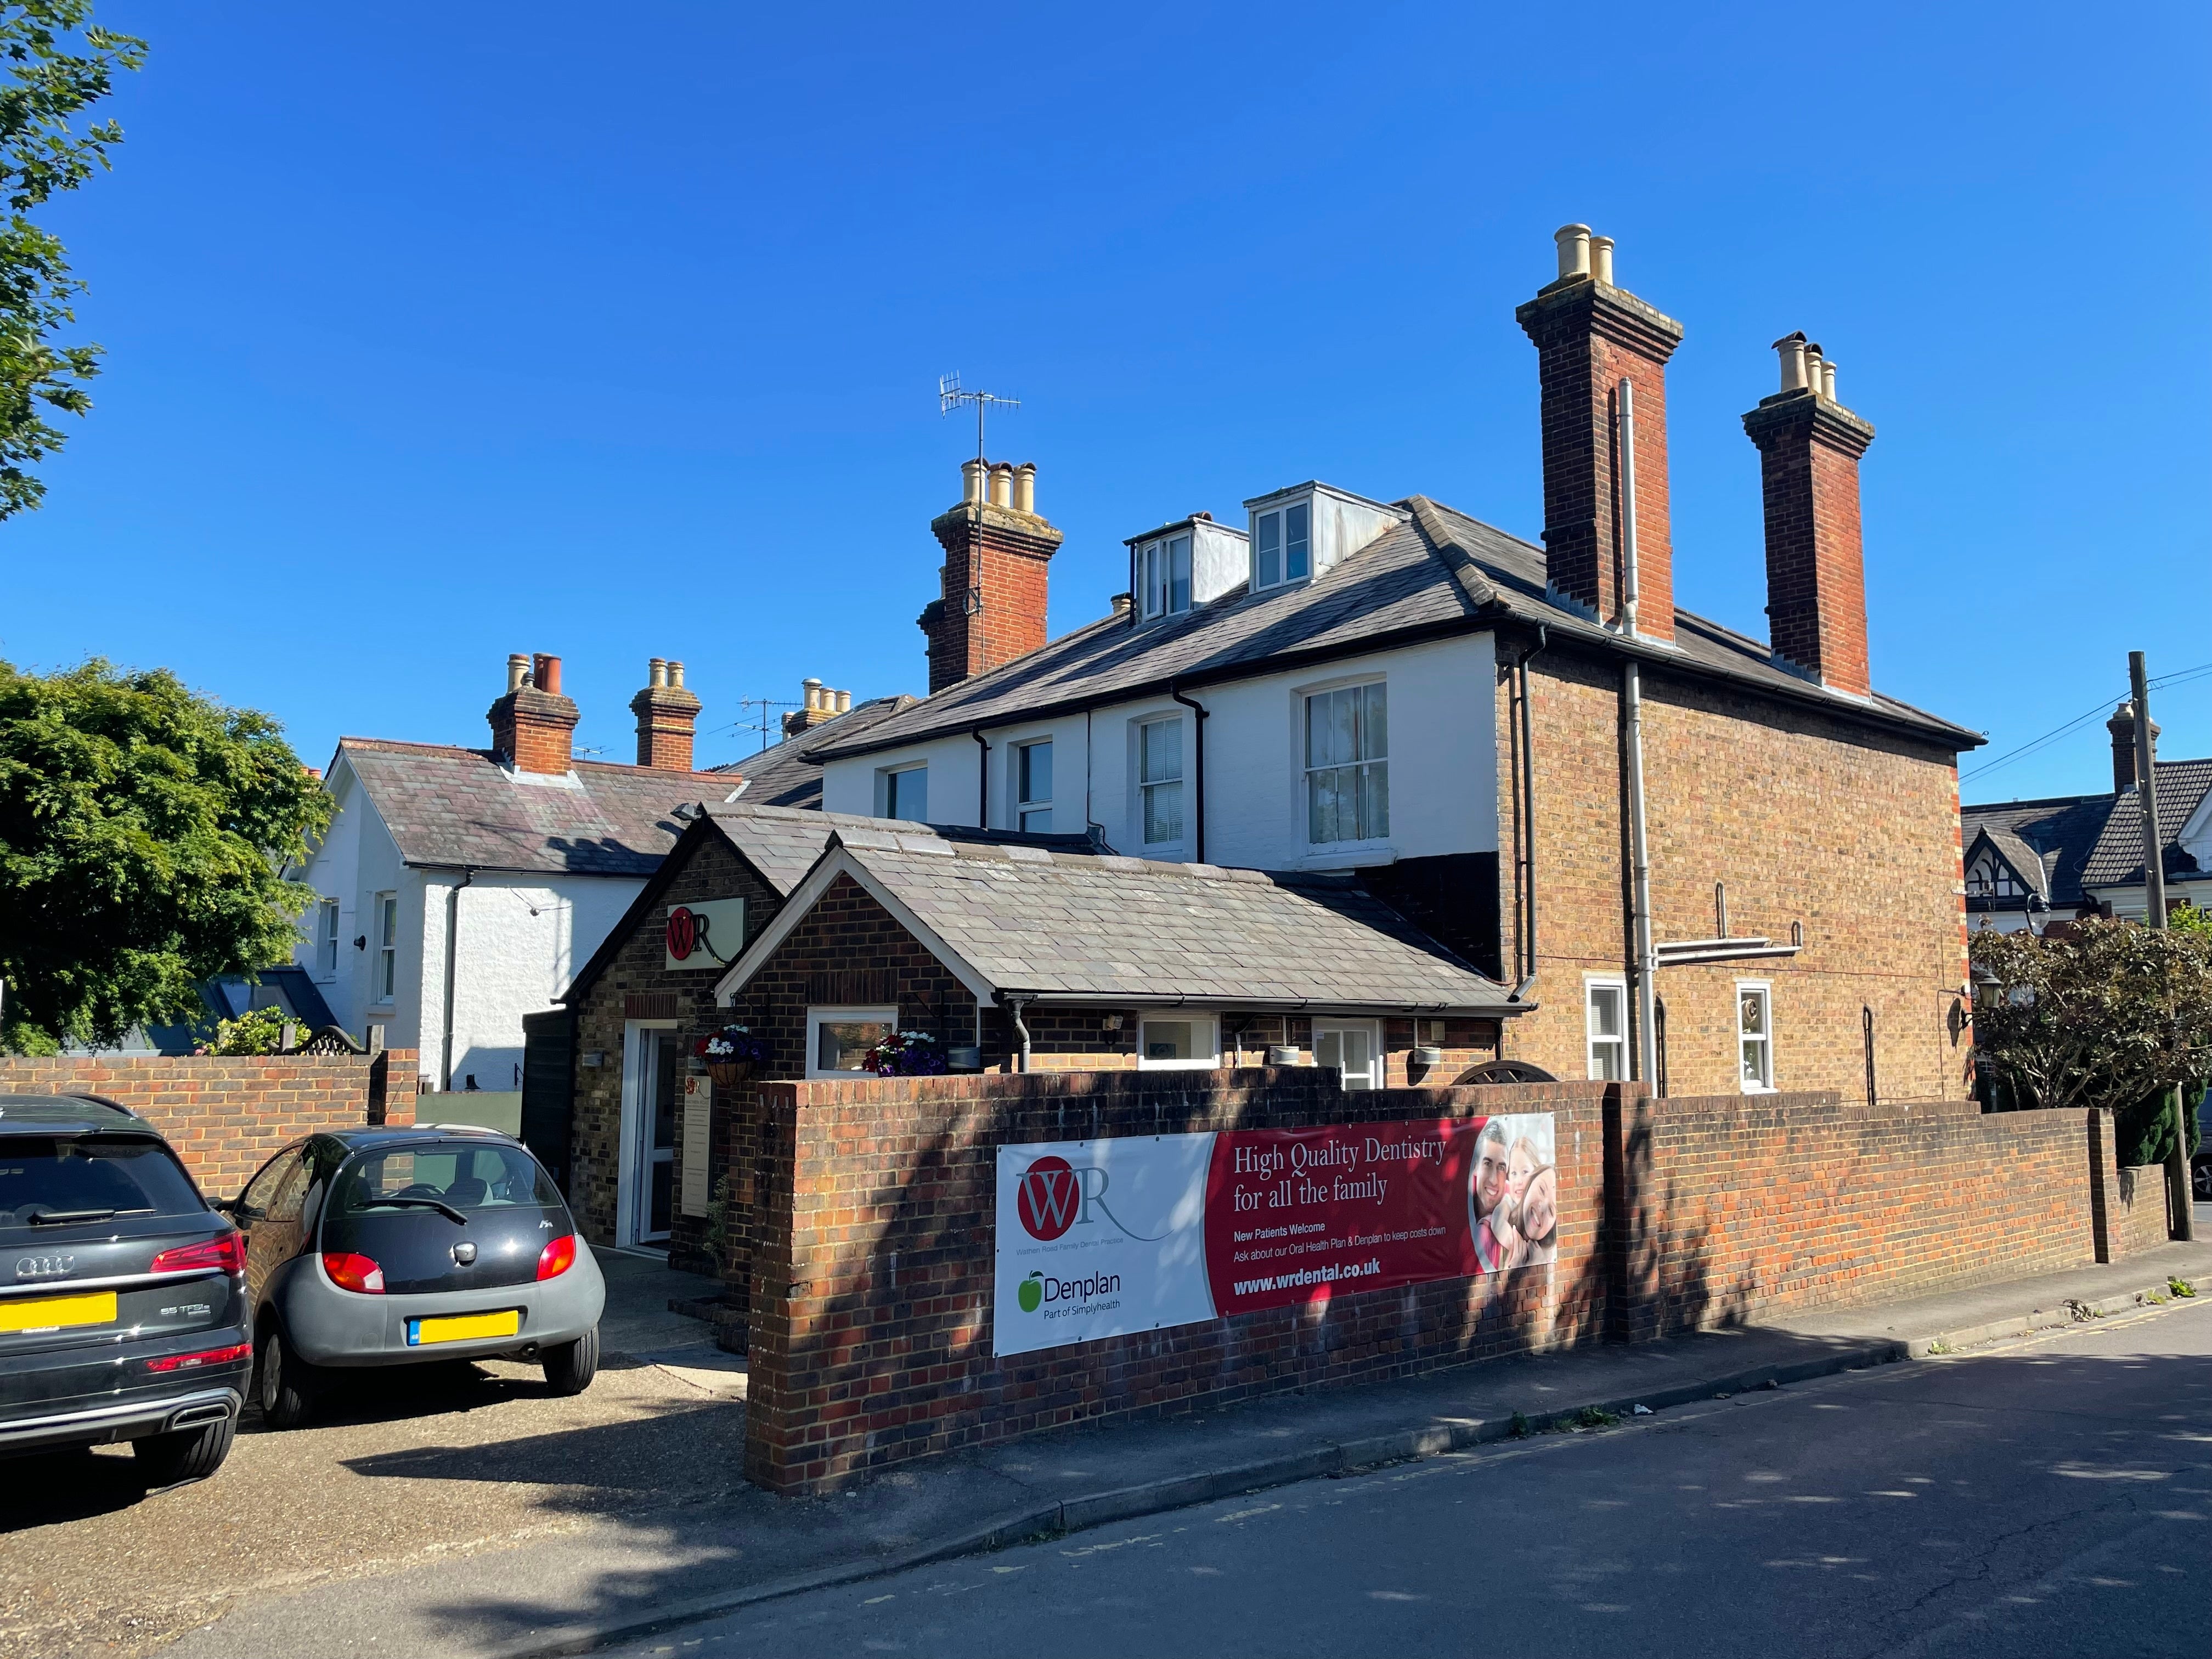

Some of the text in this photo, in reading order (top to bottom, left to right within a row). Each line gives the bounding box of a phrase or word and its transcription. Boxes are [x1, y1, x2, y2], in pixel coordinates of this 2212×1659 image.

[667, 913, 730, 966] WR
[1234, 1135, 1447, 1181] High Quality Dentistry
[1016, 1167, 1175, 1241] WR
[1234, 1172, 1388, 1211] for all the family
[1017, 1247, 1040, 1255] Wathen
[1234, 1223, 1325, 1242] New Patients Welcome
[1234, 1226, 1446, 1262] Ask about our Oral Health Plan & Denplan to keep costs down
[1045, 1271, 1120, 1303] Denplan
[1234, 1257, 1380, 1295] www.wrdental.co.uk
[1044, 1299, 1120, 1319] Part of Simplyhealth
